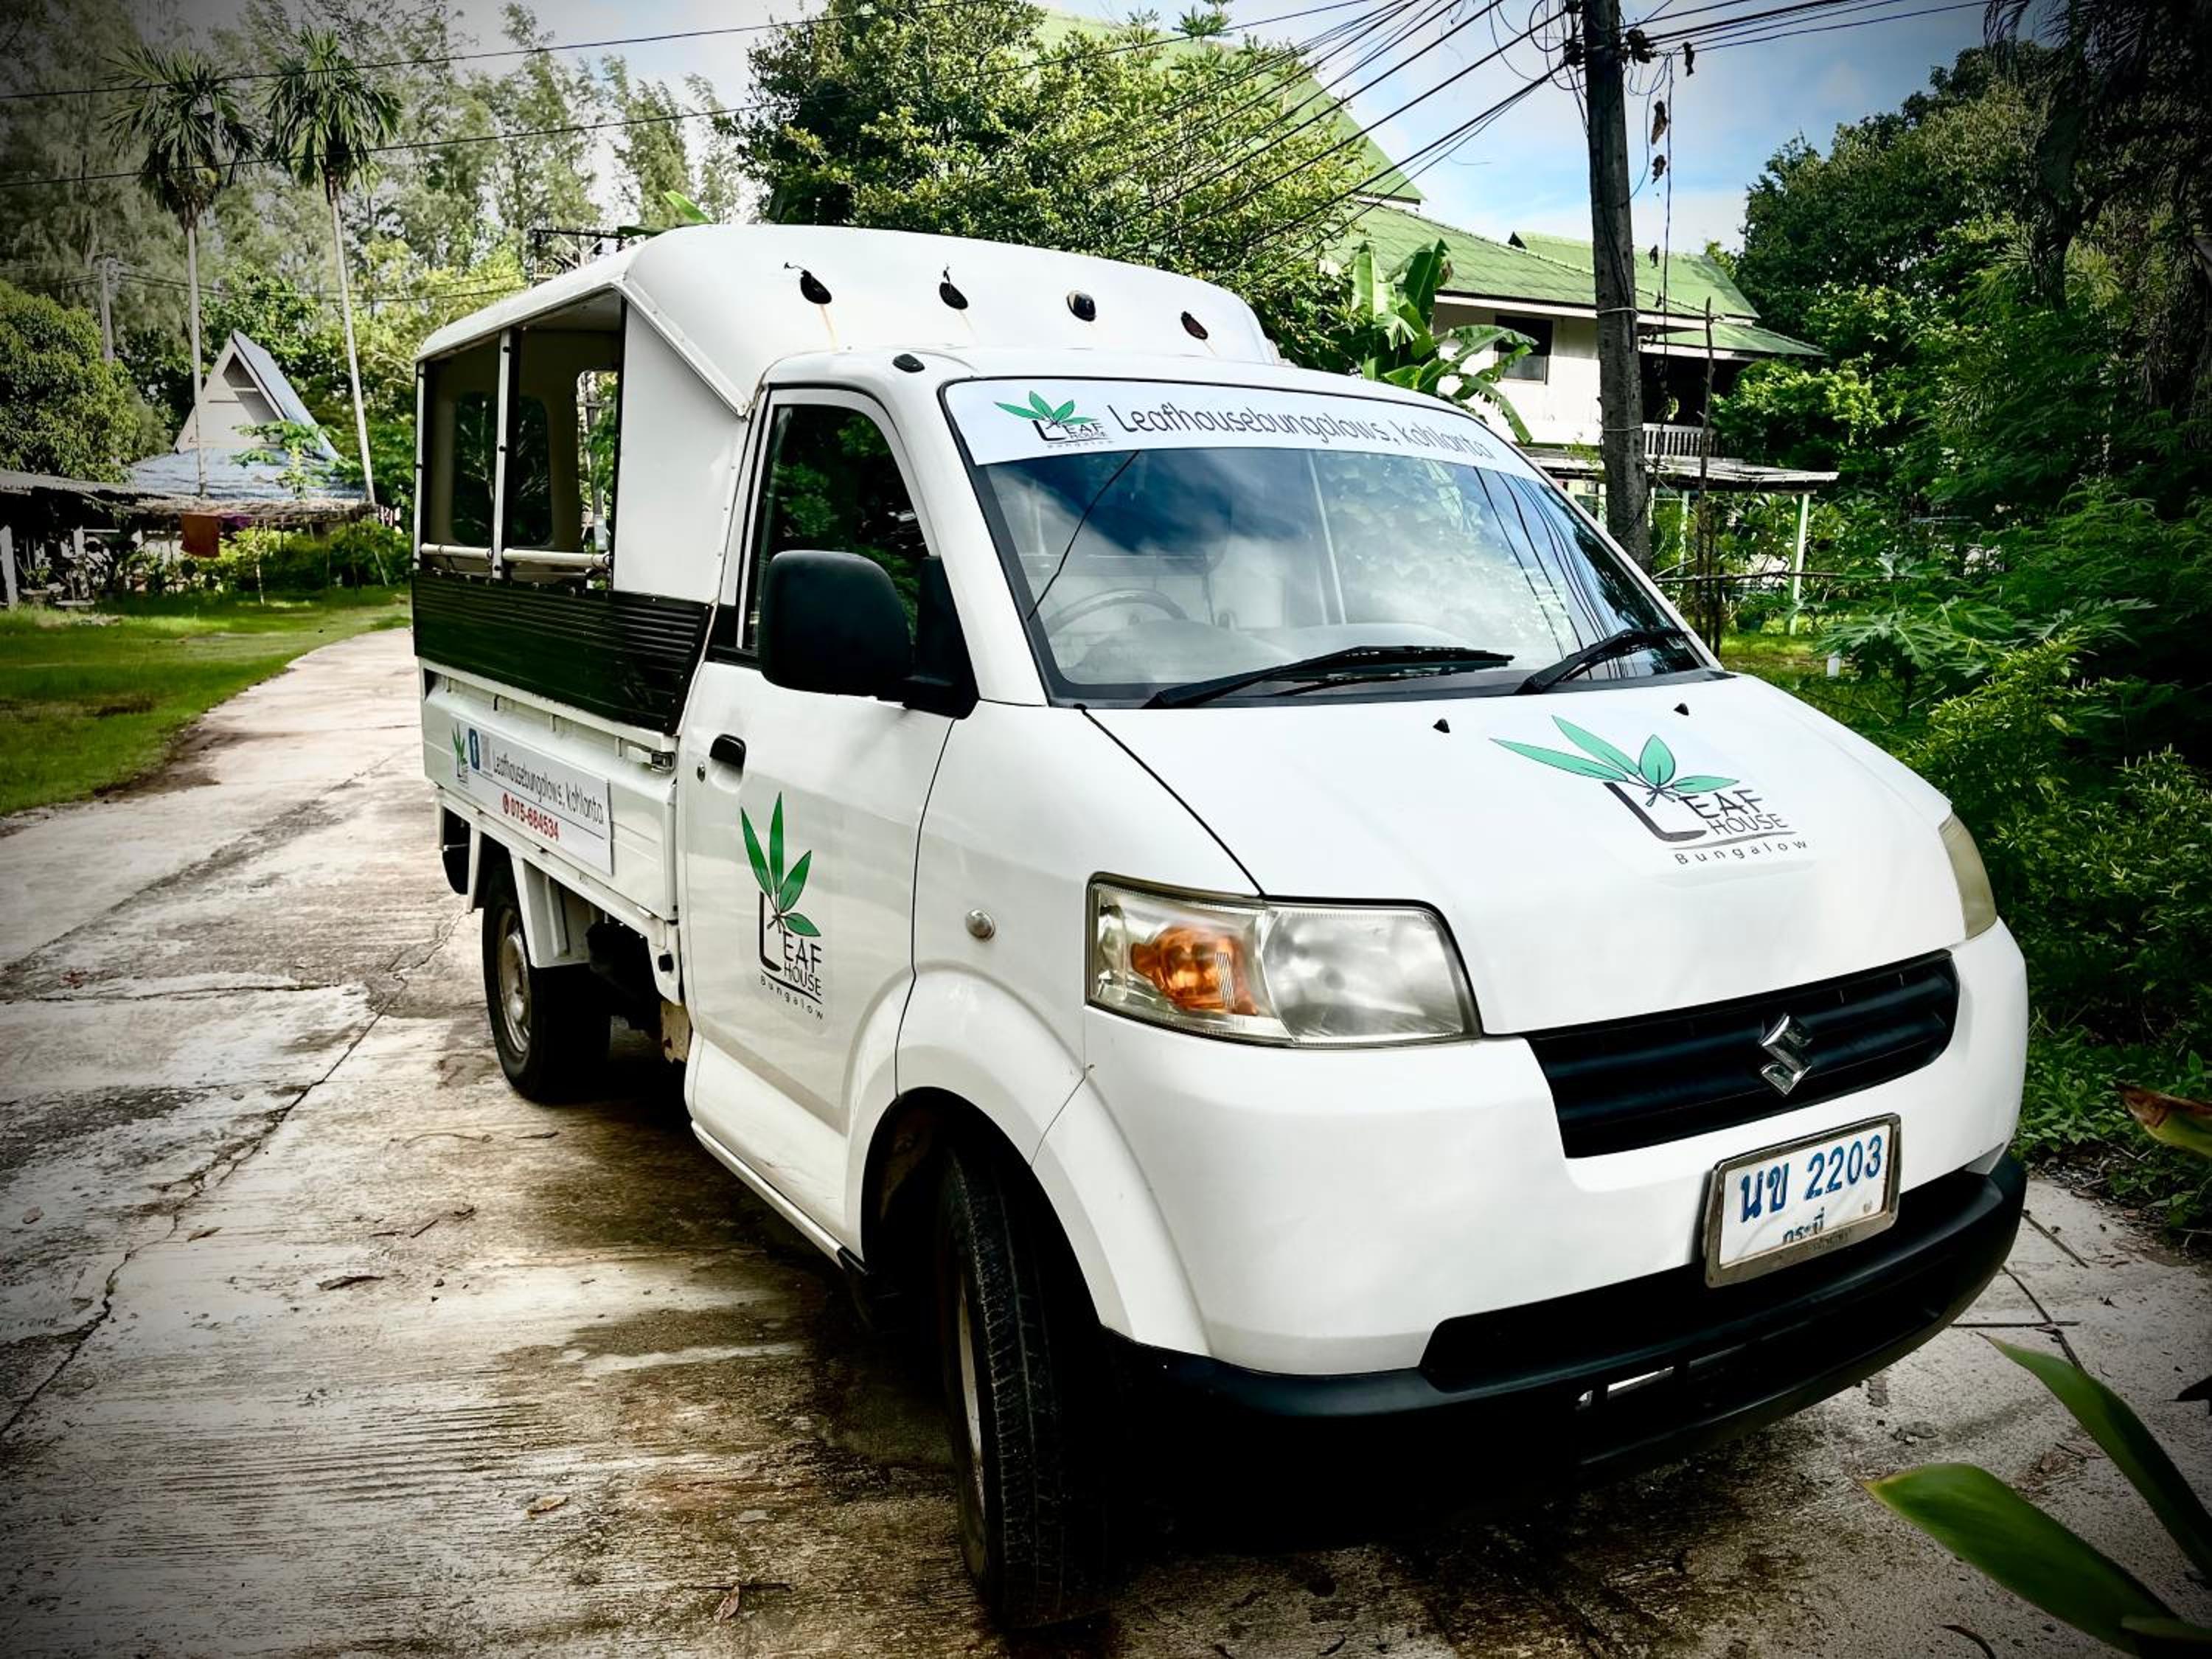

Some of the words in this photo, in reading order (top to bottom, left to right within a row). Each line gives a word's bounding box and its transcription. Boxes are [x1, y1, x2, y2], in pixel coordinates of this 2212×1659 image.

[510, 797, 559, 841] 075-684534
[1603, 782, 1763, 842] LEAF
[1707, 813, 1788, 835] HOUSE
[1674, 840, 1808, 866] Bungalow
[759, 891, 822, 973] LEAF
[760, 975, 824, 1020] Bungalow
[784, 965, 822, 996] HOUSE
[1740, 1163, 1790, 1223] นข
[1804, 1135, 1883, 1201] 2203
